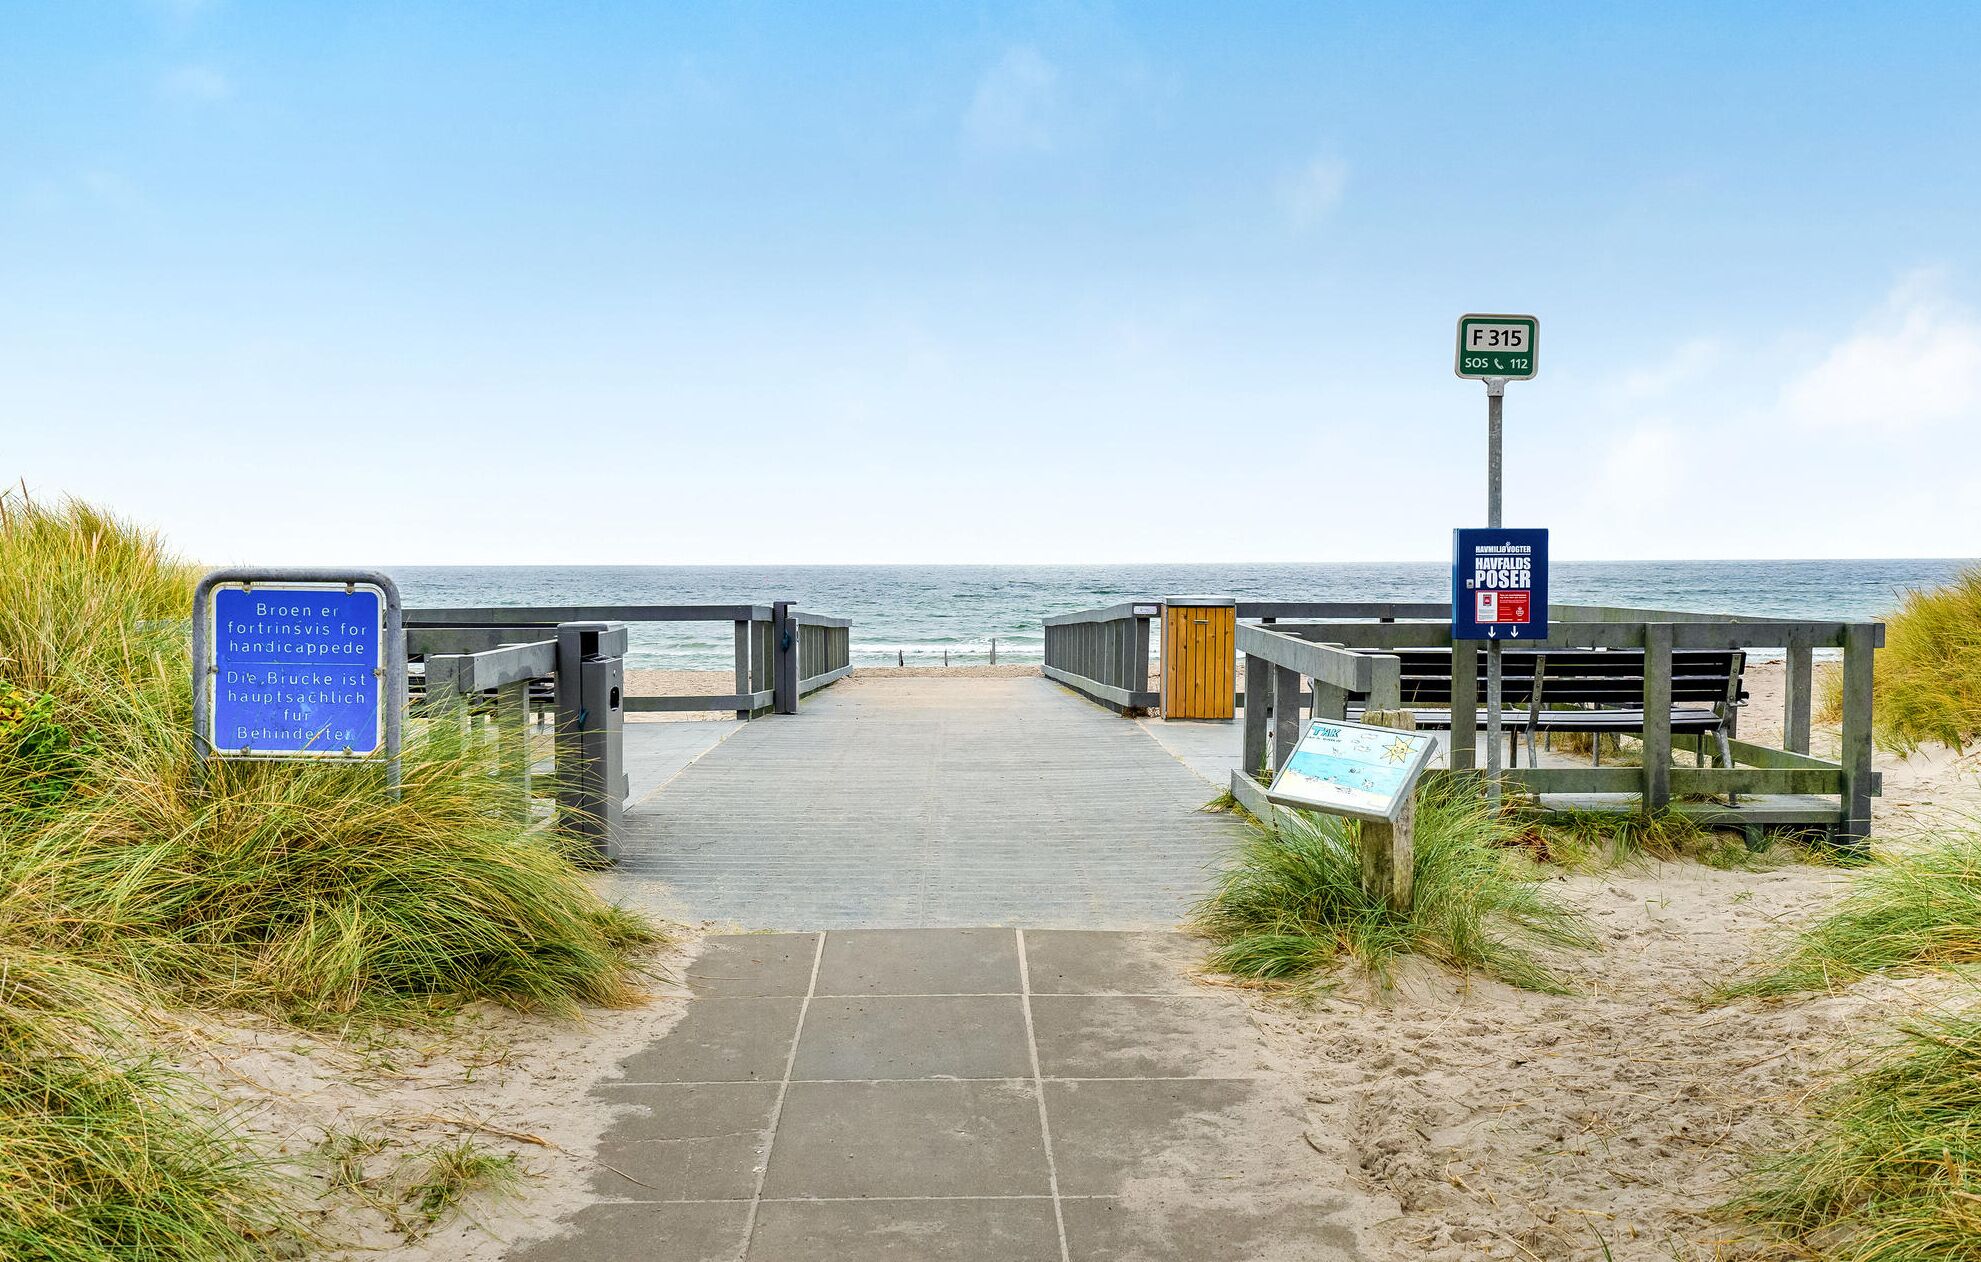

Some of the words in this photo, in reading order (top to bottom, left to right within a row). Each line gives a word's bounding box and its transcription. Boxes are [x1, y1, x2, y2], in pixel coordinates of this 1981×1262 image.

[1473, 329, 1483, 346] F
[1488, 329, 1522, 347] 315
[1465, 357, 1489, 368] SOS
[1510, 358, 1528, 369] 112
[1475, 557, 1531, 570] HAVFALDS
[1475, 570, 1531, 589] POSER
[256, 603, 311, 617] Broen
[321, 606, 338, 617] er
[227, 621, 330, 635] fortrinsvis
[340, 623, 367, 635] for
[229, 640, 365, 656] handicappede
[227, 671, 257, 684] Die
[342, 672, 366, 686] ist
